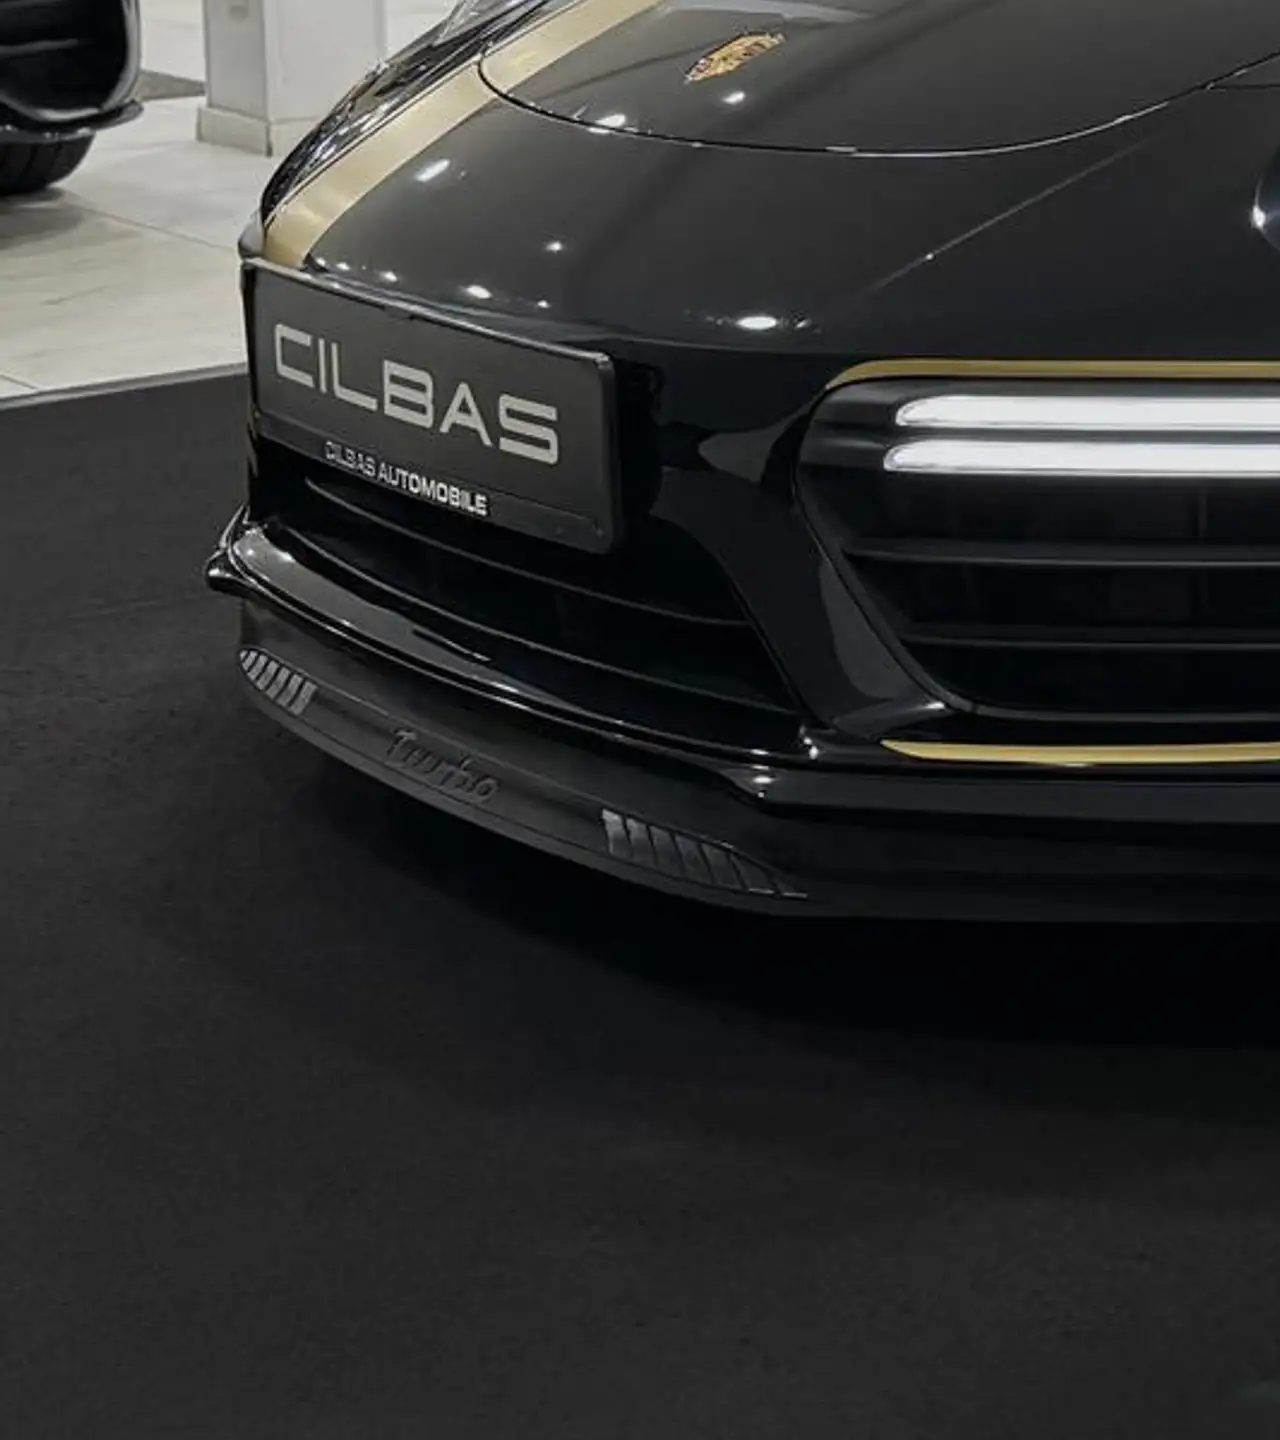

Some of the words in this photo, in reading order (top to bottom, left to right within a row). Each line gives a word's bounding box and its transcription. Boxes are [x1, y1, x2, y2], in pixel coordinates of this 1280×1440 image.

[274, 323, 559, 465] CILBAS
[324, 440, 376, 477] CILBAS
[377, 462, 488, 516] AUTOMOBILE
